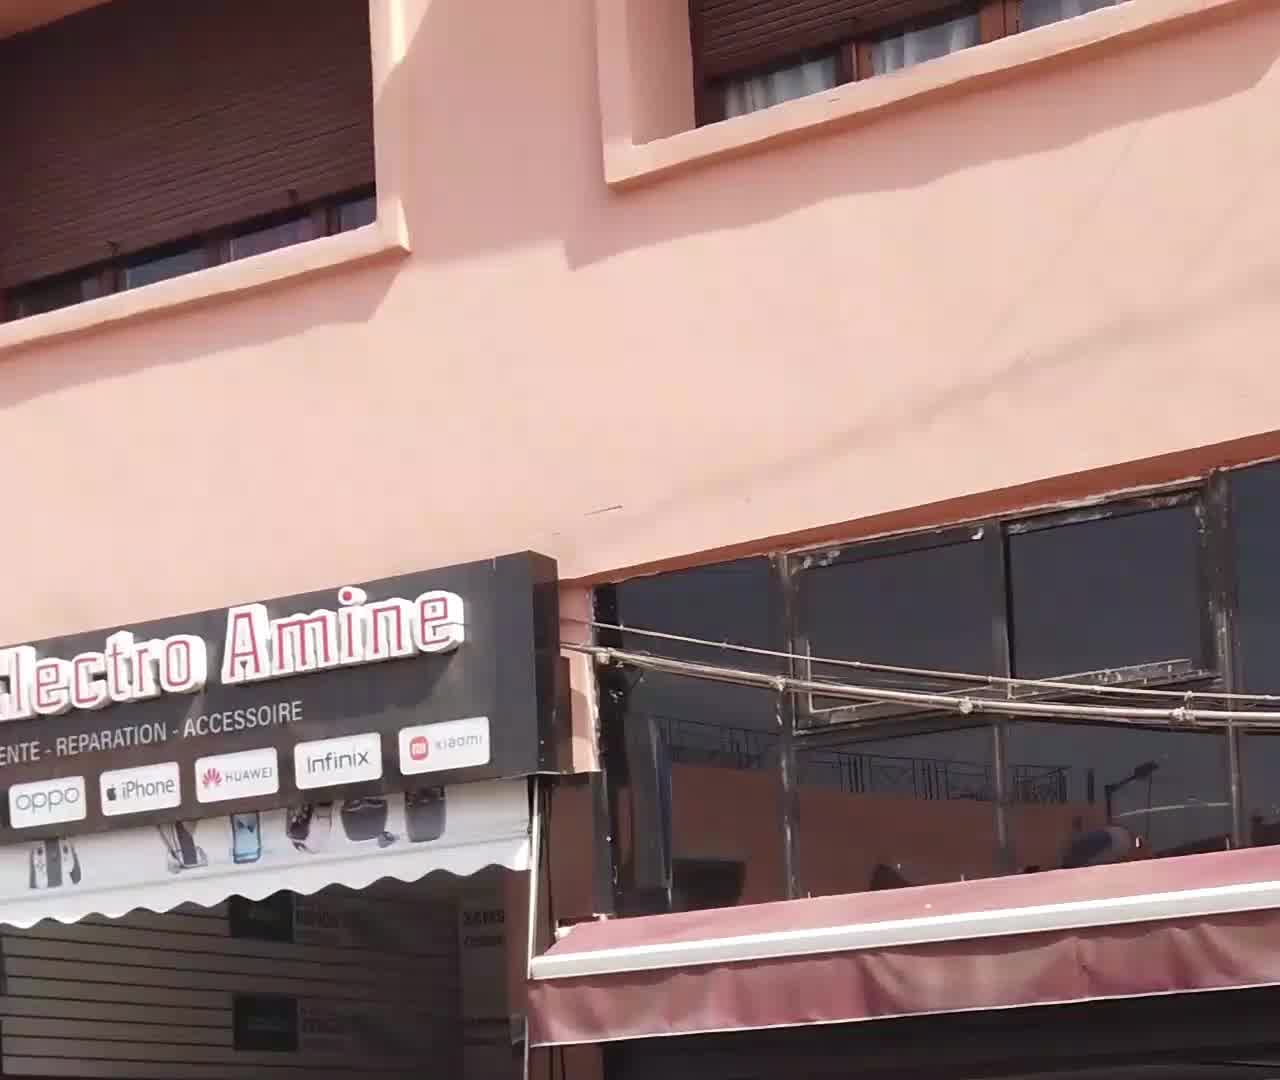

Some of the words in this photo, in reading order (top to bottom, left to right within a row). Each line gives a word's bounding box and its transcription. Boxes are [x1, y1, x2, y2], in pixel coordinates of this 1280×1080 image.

[221, 586, 465, 684] Amine
[57, 721, 167, 757] REPARATION
[183, 700, 304, 740] ACCESSOIRE
[434, 734, 483, 751] xiaomi
[225, 767, 273, 783] HUAWEI
[15, 787, 80, 813] oppo
[121, 777, 176, 799] iPhone
